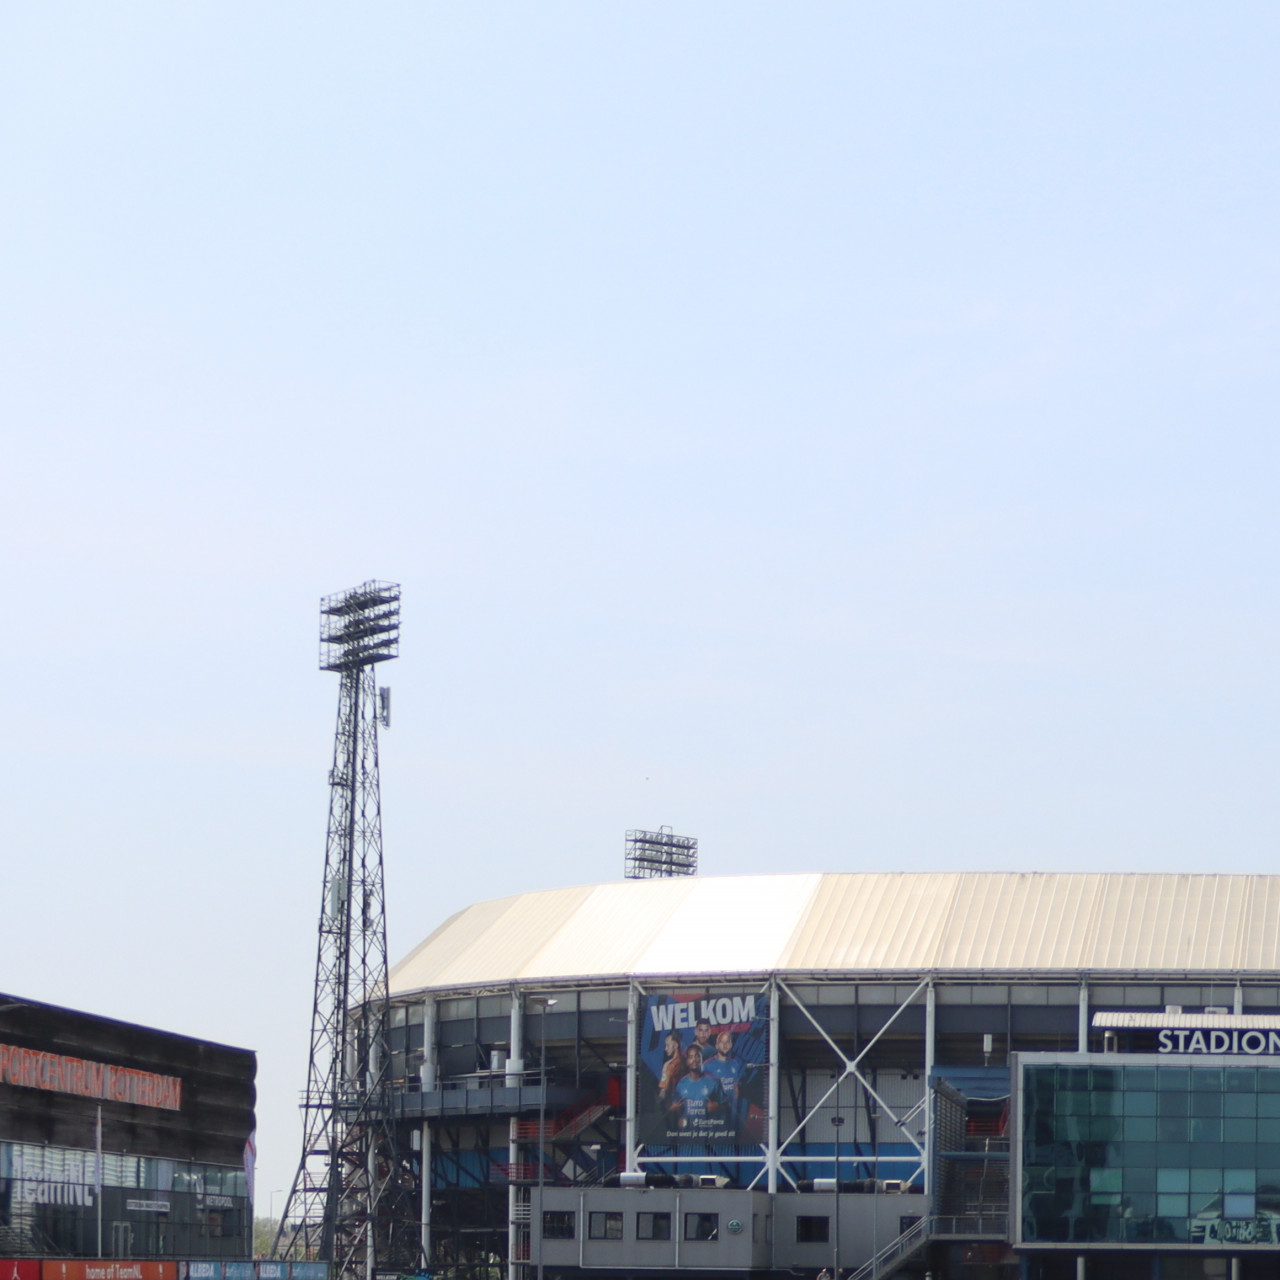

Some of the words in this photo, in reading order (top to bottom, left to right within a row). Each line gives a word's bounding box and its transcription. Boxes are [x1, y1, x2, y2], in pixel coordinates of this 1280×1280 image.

[650, 995, 756, 1031] WELKOM
[108, 1064, 182, 1111] ROTTERDAM
[85, 1264, 105, 1280] home
[106, 1263, 115, 1280] of
[115, 1263, 143, 1280] TeamNL
[189, 1261, 215, 1278] ALBEDA
